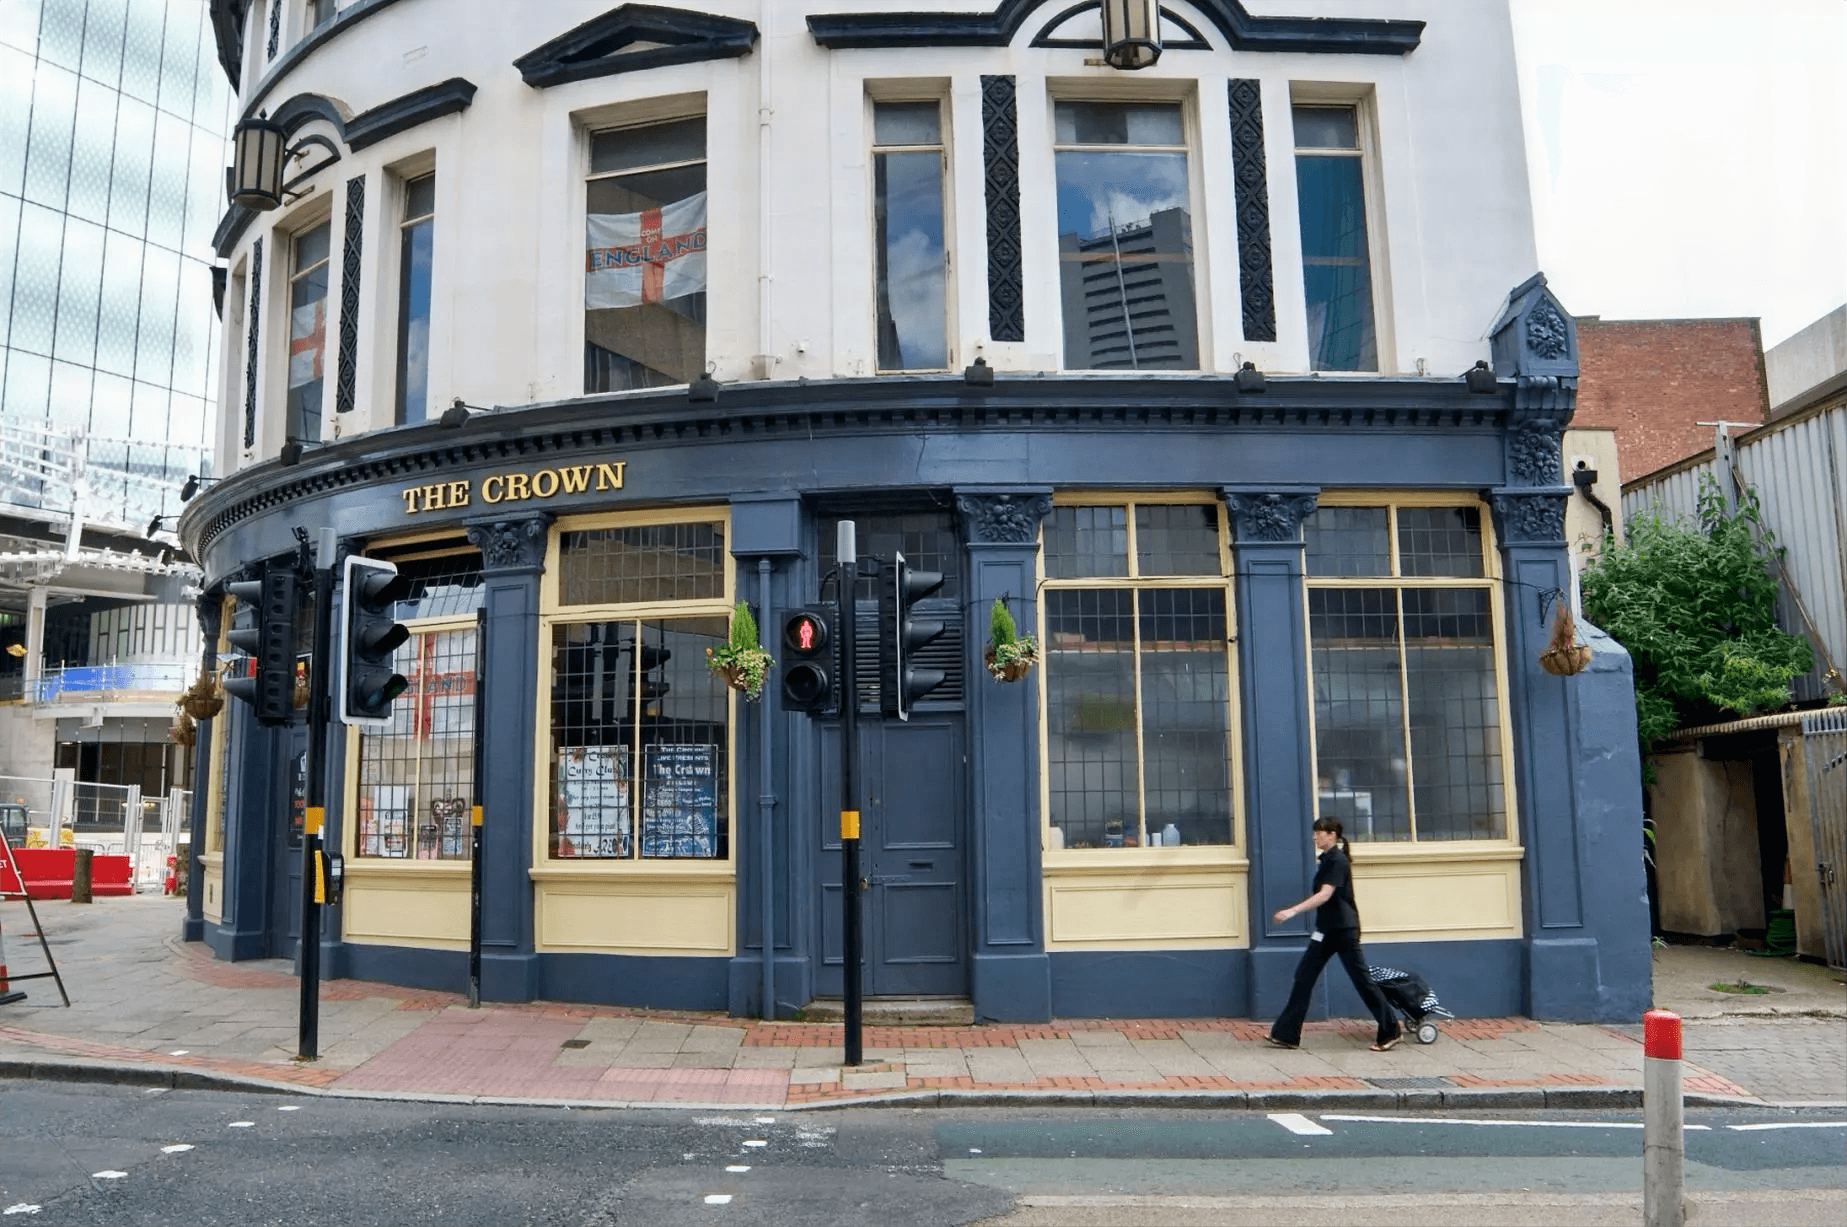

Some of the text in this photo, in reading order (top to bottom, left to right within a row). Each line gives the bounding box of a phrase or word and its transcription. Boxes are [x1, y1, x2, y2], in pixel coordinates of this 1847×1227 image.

[591, 231, 707, 269] ENGLAND
[402, 461, 627, 514] THE CROWN
[406, 677, 466, 693] GLAND
[567, 766, 593, 777] Cury
